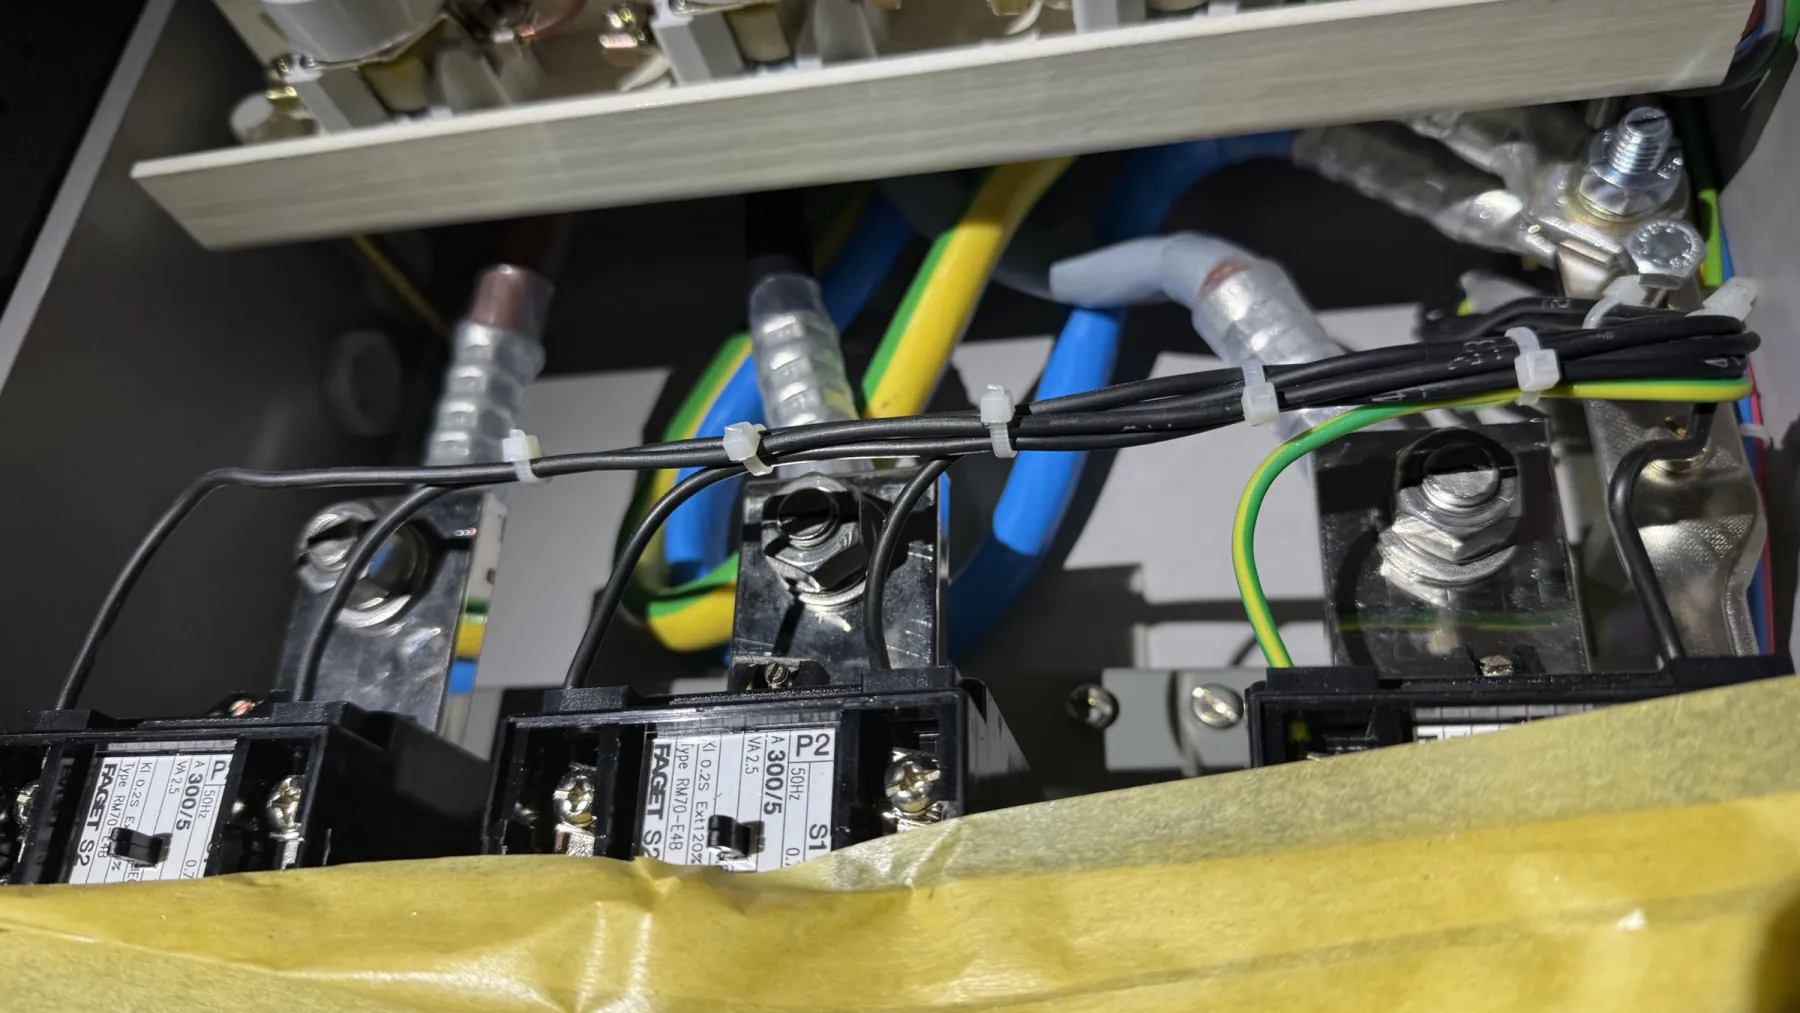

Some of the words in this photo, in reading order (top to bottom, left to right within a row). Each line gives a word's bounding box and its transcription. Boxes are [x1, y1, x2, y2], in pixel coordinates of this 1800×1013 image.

[747, 736, 762, 754] VA
[772, 735, 785, 744] A
[796, 733, 831, 757] P2
[174, 760, 188, 775] VA
[195, 760, 205, 768] A
[676, 743, 695, 770] Type
[745, 757, 759, 774] 2.5
[117, 763, 135, 787] Type
[169, 777, 183, 795] 2.5
[648, 743, 672, 820] FAGET
[698, 759, 712, 792] 0.2S
[763, 750, 786, 815] 300/5
[789, 767, 806, 801] 50Hz
[86, 763, 118, 831] FAGET
[129, 780, 145, 807] 0.2S
[176, 773, 203, 831] 300/5
[198, 789, 216, 818] 50Hz
[668, 778, 691, 851] RM70-E4B
[643, 830, 663, 858] S2
[808, 823, 829, 851] S1
[77, 839, 95, 867] S2
